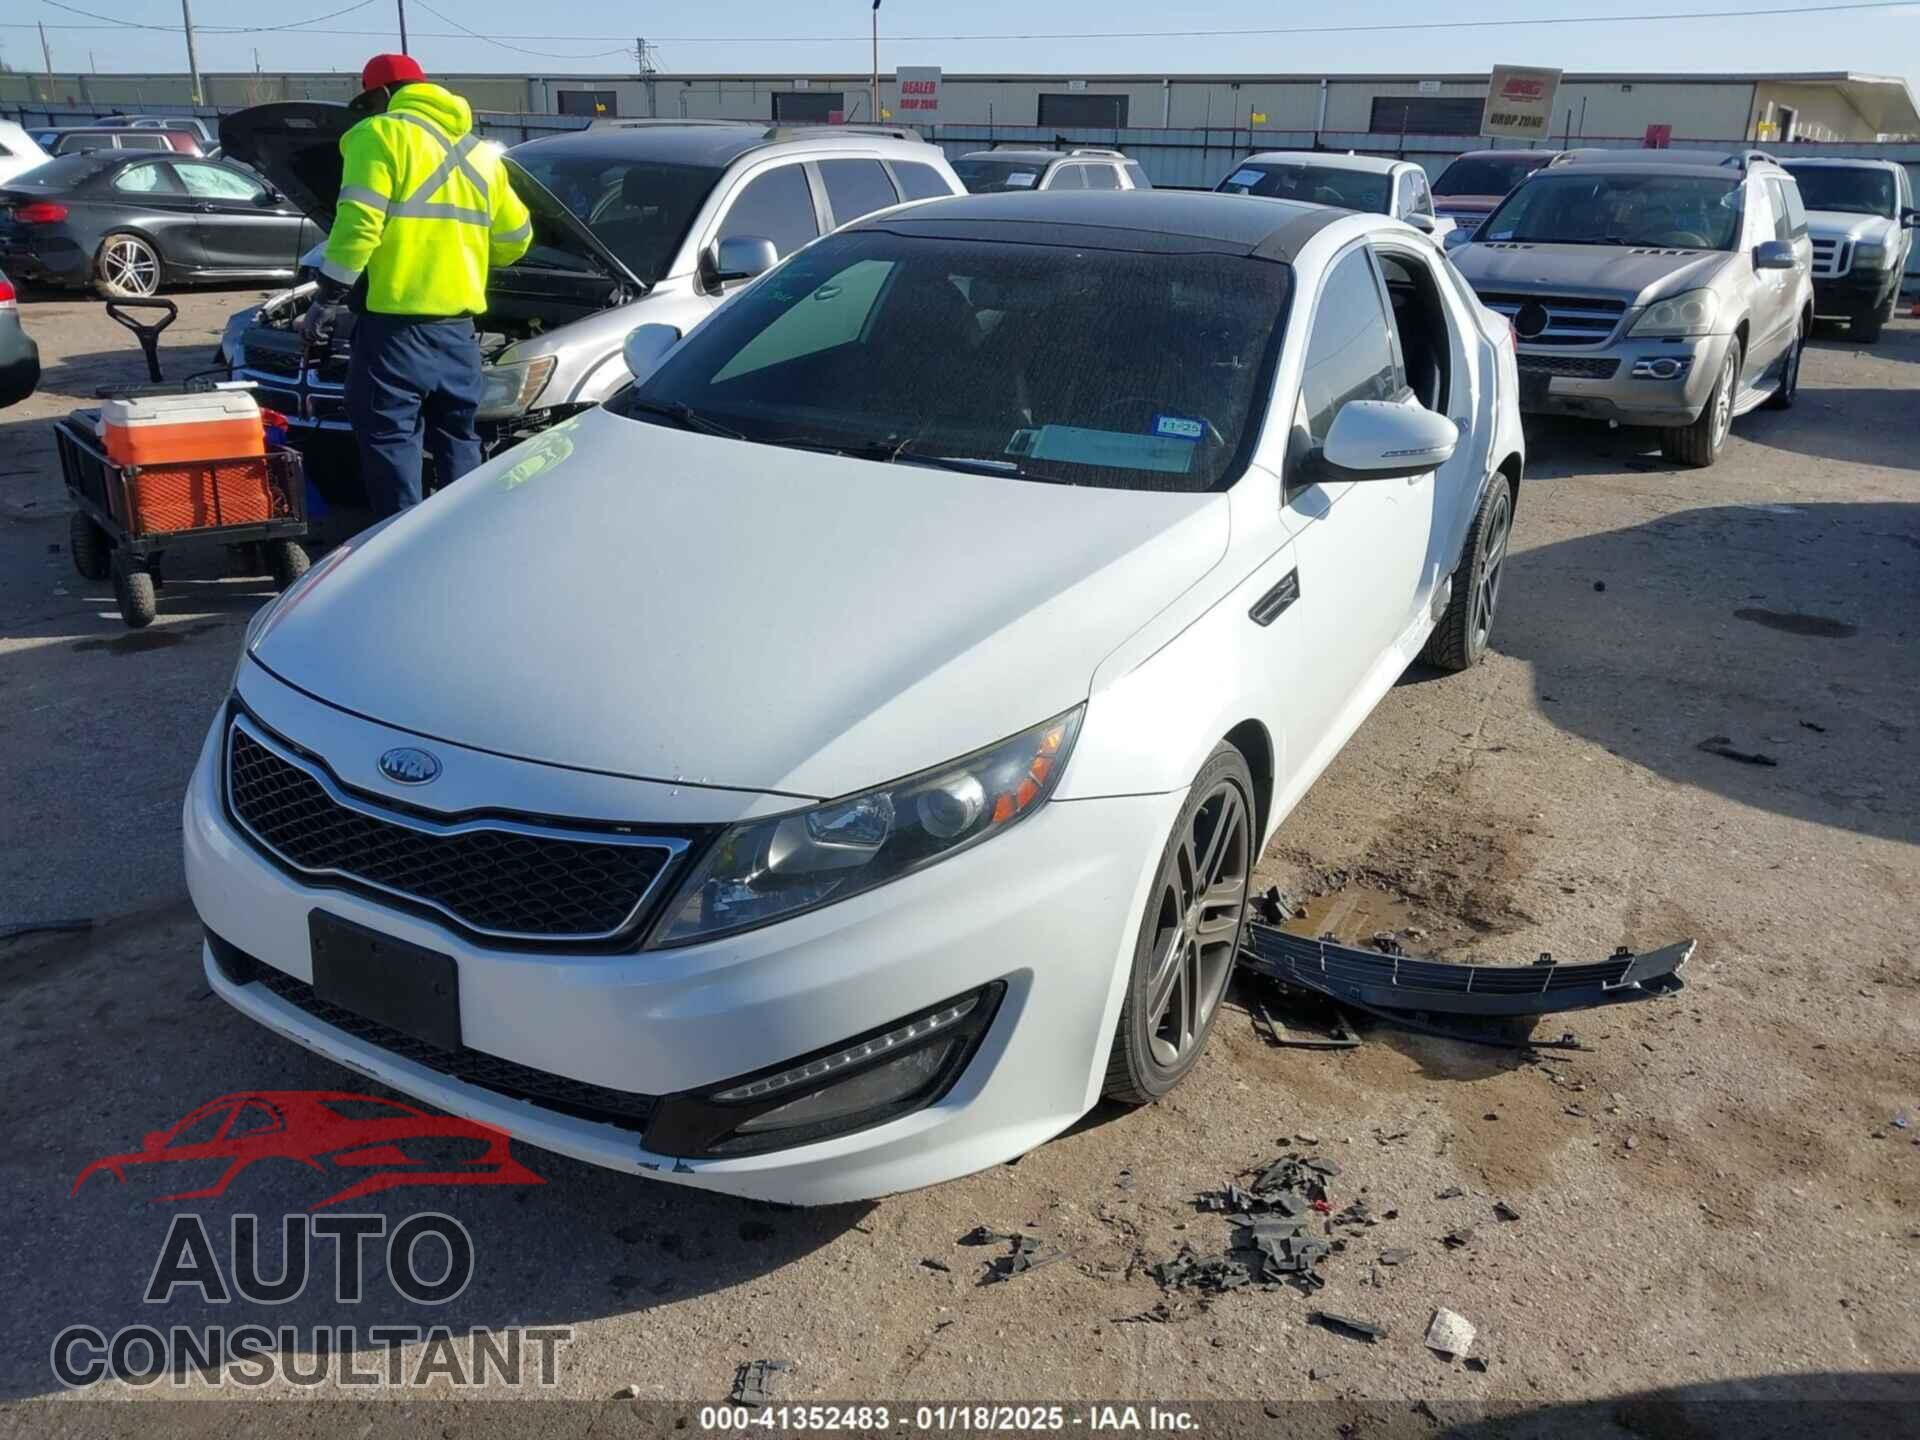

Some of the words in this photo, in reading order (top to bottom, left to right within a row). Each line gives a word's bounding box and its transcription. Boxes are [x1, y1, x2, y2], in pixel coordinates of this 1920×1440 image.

[902, 80, 936, 95] DEALER
[1490, 112, 1518, 126] DROP
[1518, 114, 1544, 129] ZONE
[1161, 420, 1199, 433] 11-25
[383, 750, 434, 779] KIA
